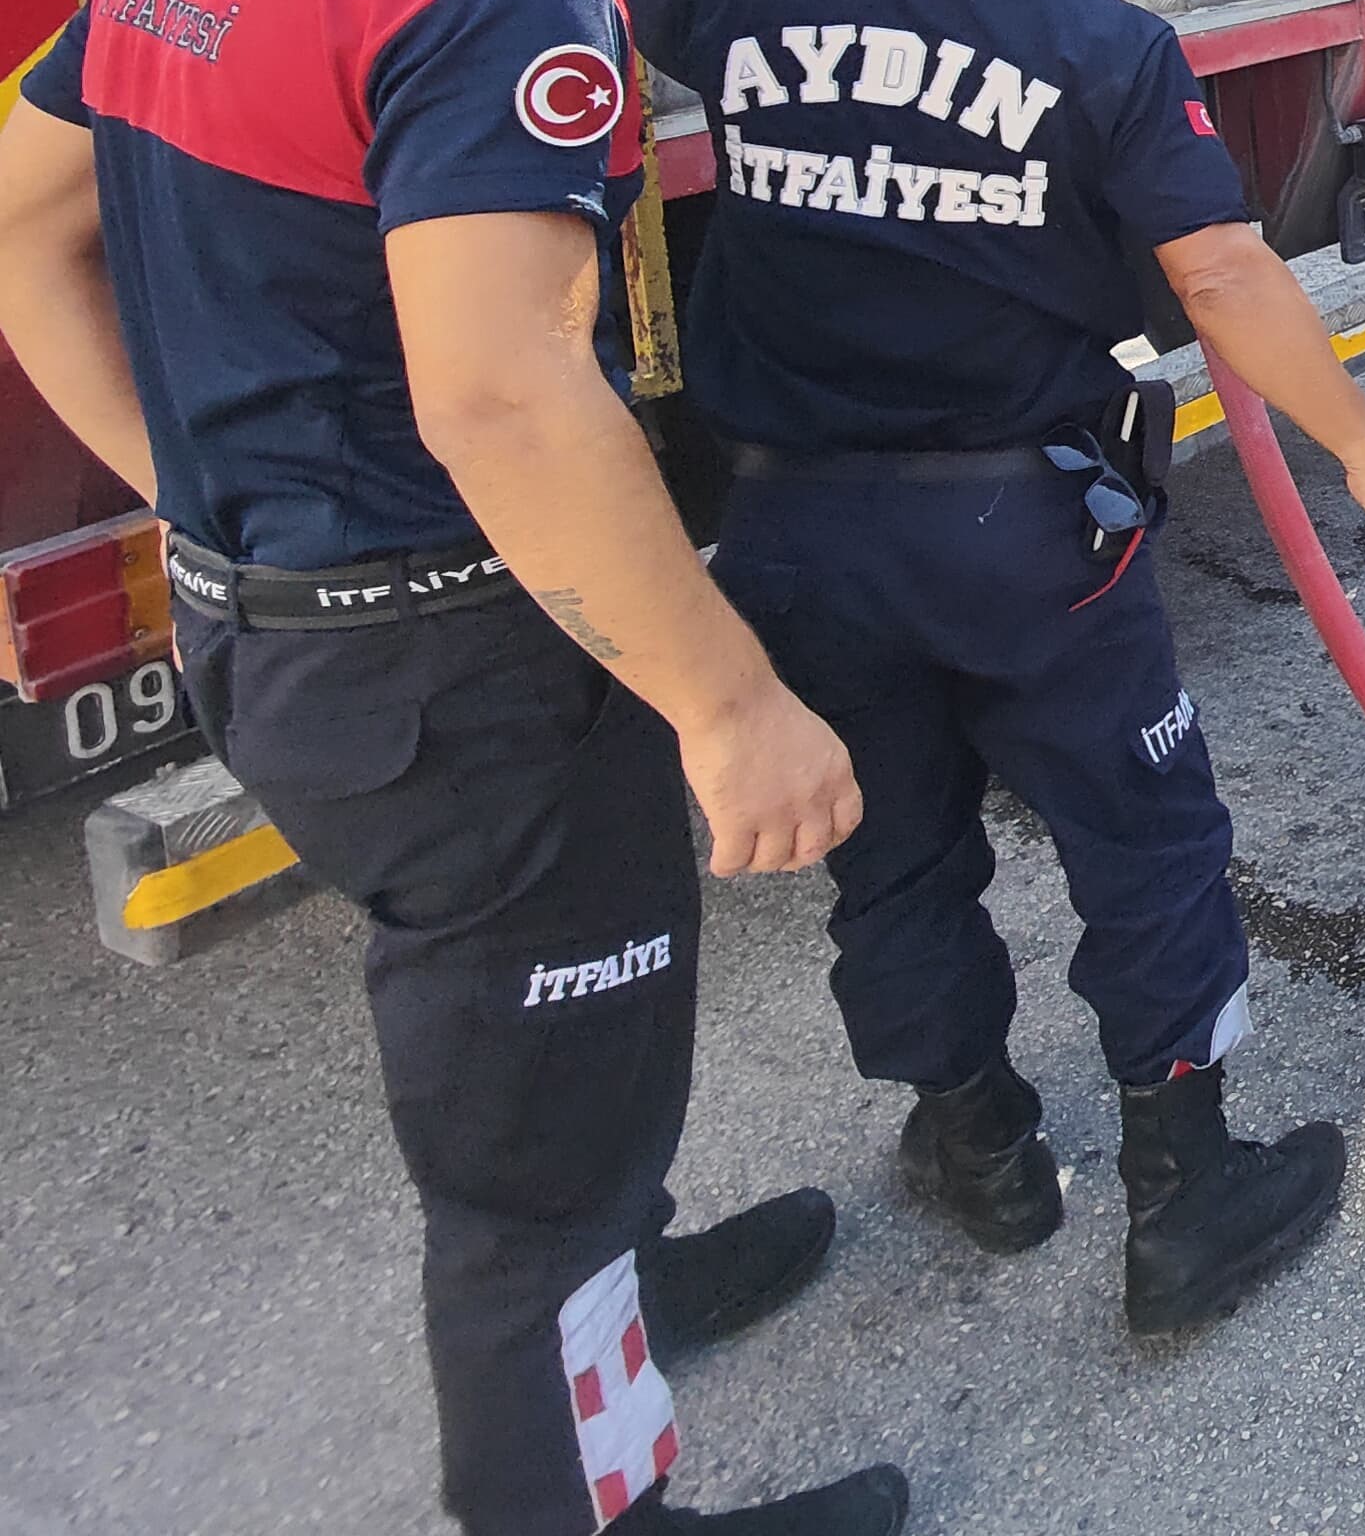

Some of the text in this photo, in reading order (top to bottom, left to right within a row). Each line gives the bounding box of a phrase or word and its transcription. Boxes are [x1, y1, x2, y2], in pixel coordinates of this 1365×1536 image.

[719, 23, 1063, 153] AYDIN
[723, 123, 1049, 227] İTFAİYESİ
[64, 660, 176, 760] 09
[523, 932, 672, 1008] İTFAİYE
